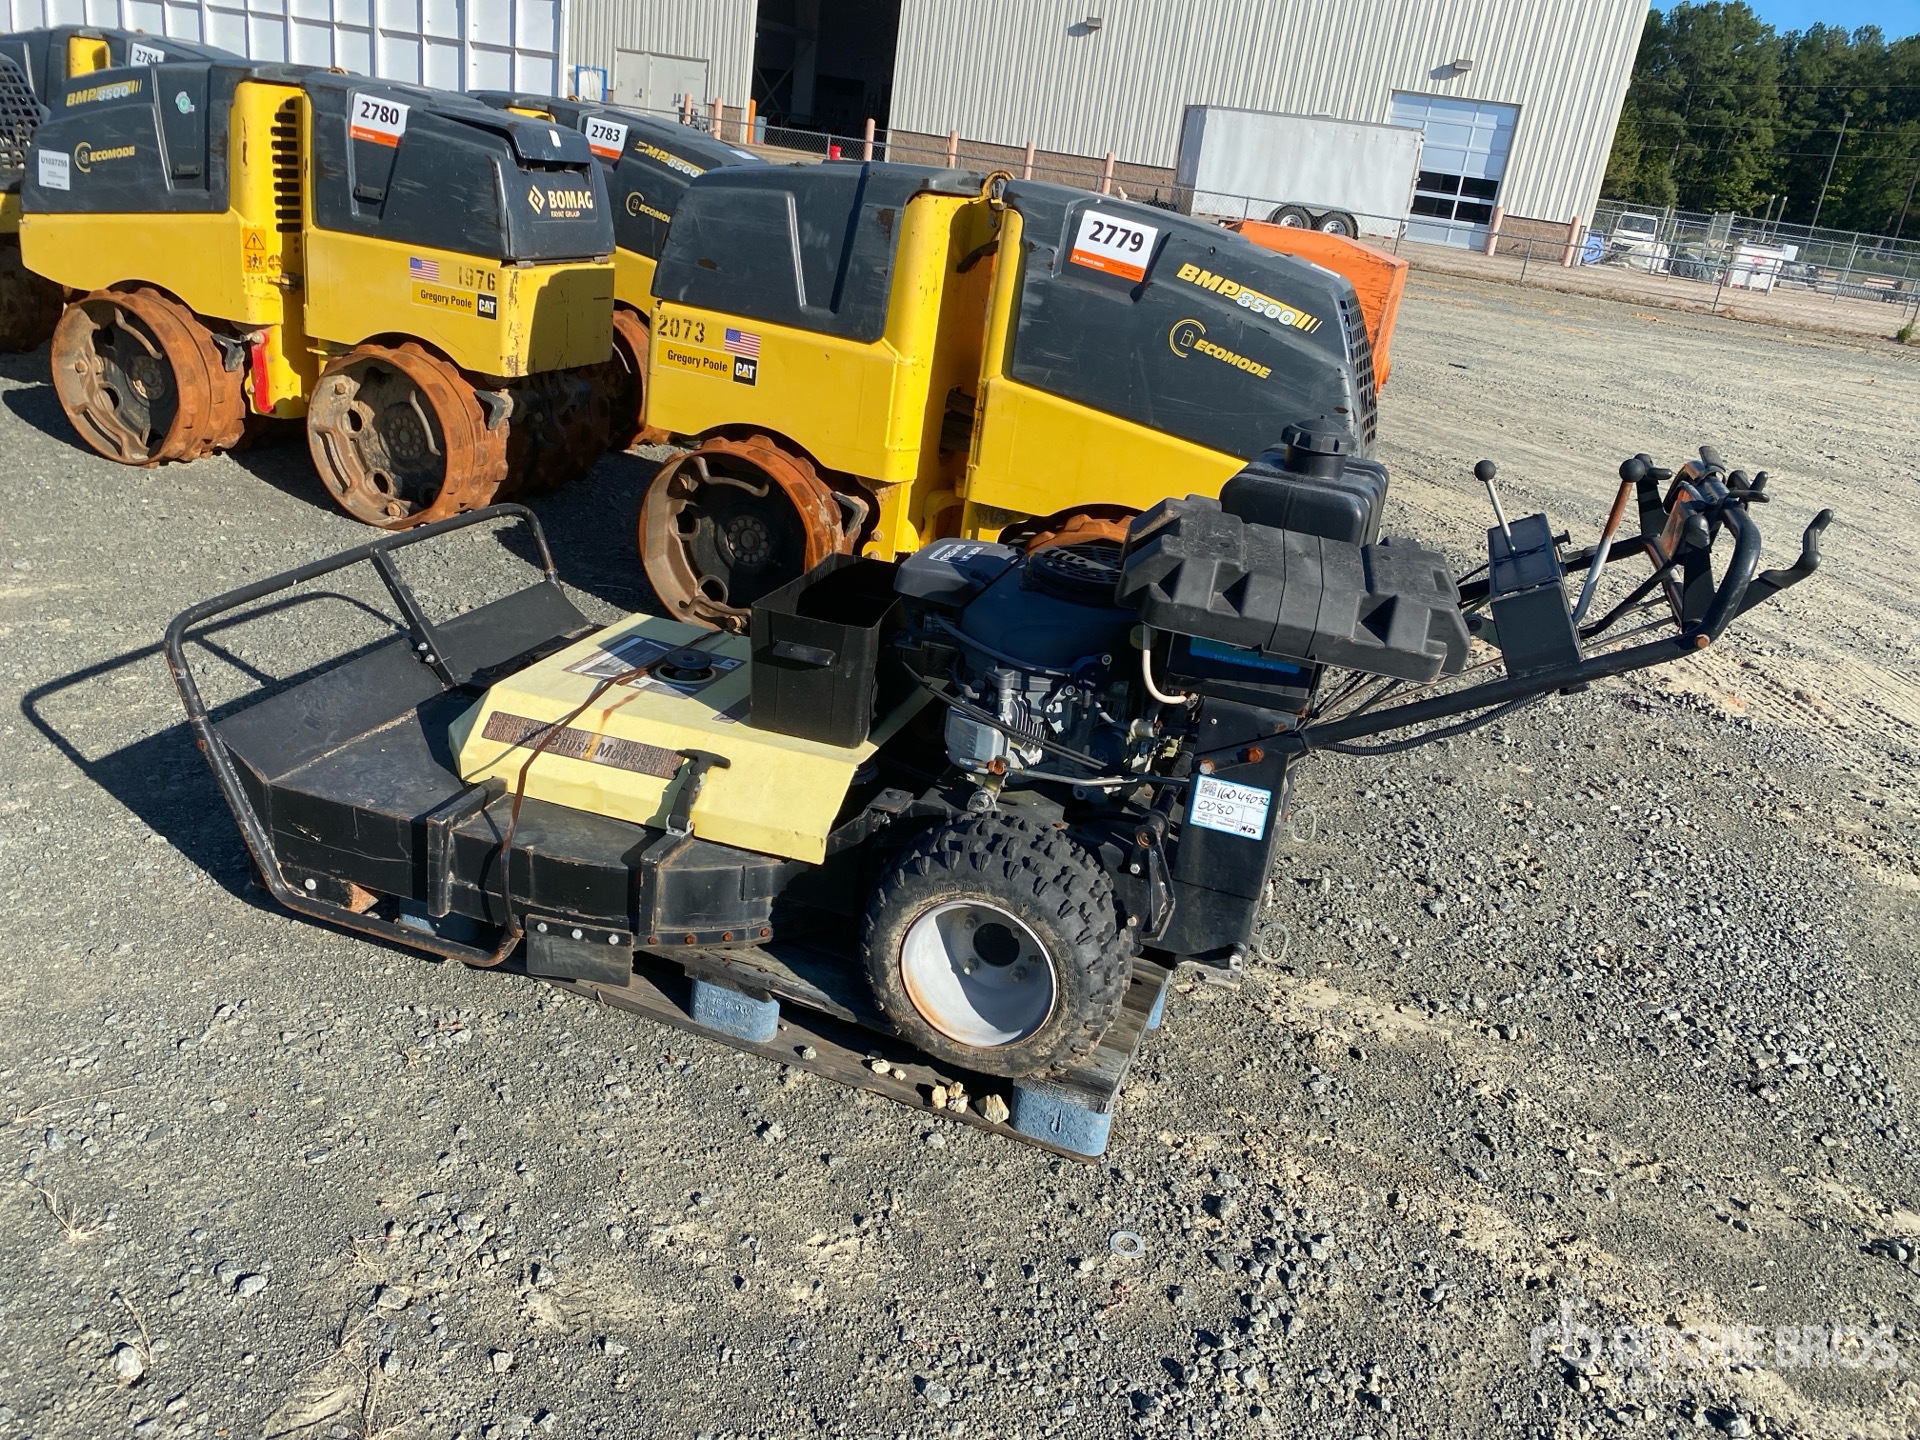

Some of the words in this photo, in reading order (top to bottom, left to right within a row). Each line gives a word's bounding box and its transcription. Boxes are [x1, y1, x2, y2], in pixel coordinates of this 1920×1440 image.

[361, 101, 399, 125] 2780
[591, 124, 620, 142] 2783
[89, 146, 135, 162] ECOMODE
[547, 190, 594, 209] BOMAG
[1088, 220, 1144, 253] 2779
[458, 266, 496, 291] 1976
[420, 289, 450, 305] Gregory
[450, 294, 472, 308] Poole
[1176, 263, 1297, 326] BMP8500
[478, 298, 496, 314] CAT
[657, 315, 706, 343] 2073
[667, 349, 701, 368] Gregory
[703, 357, 728, 372] Poole
[1193, 338, 1273, 379] ECOMODE
[735, 362, 756, 379] CAT
[1198, 800, 1235, 815] 0080
